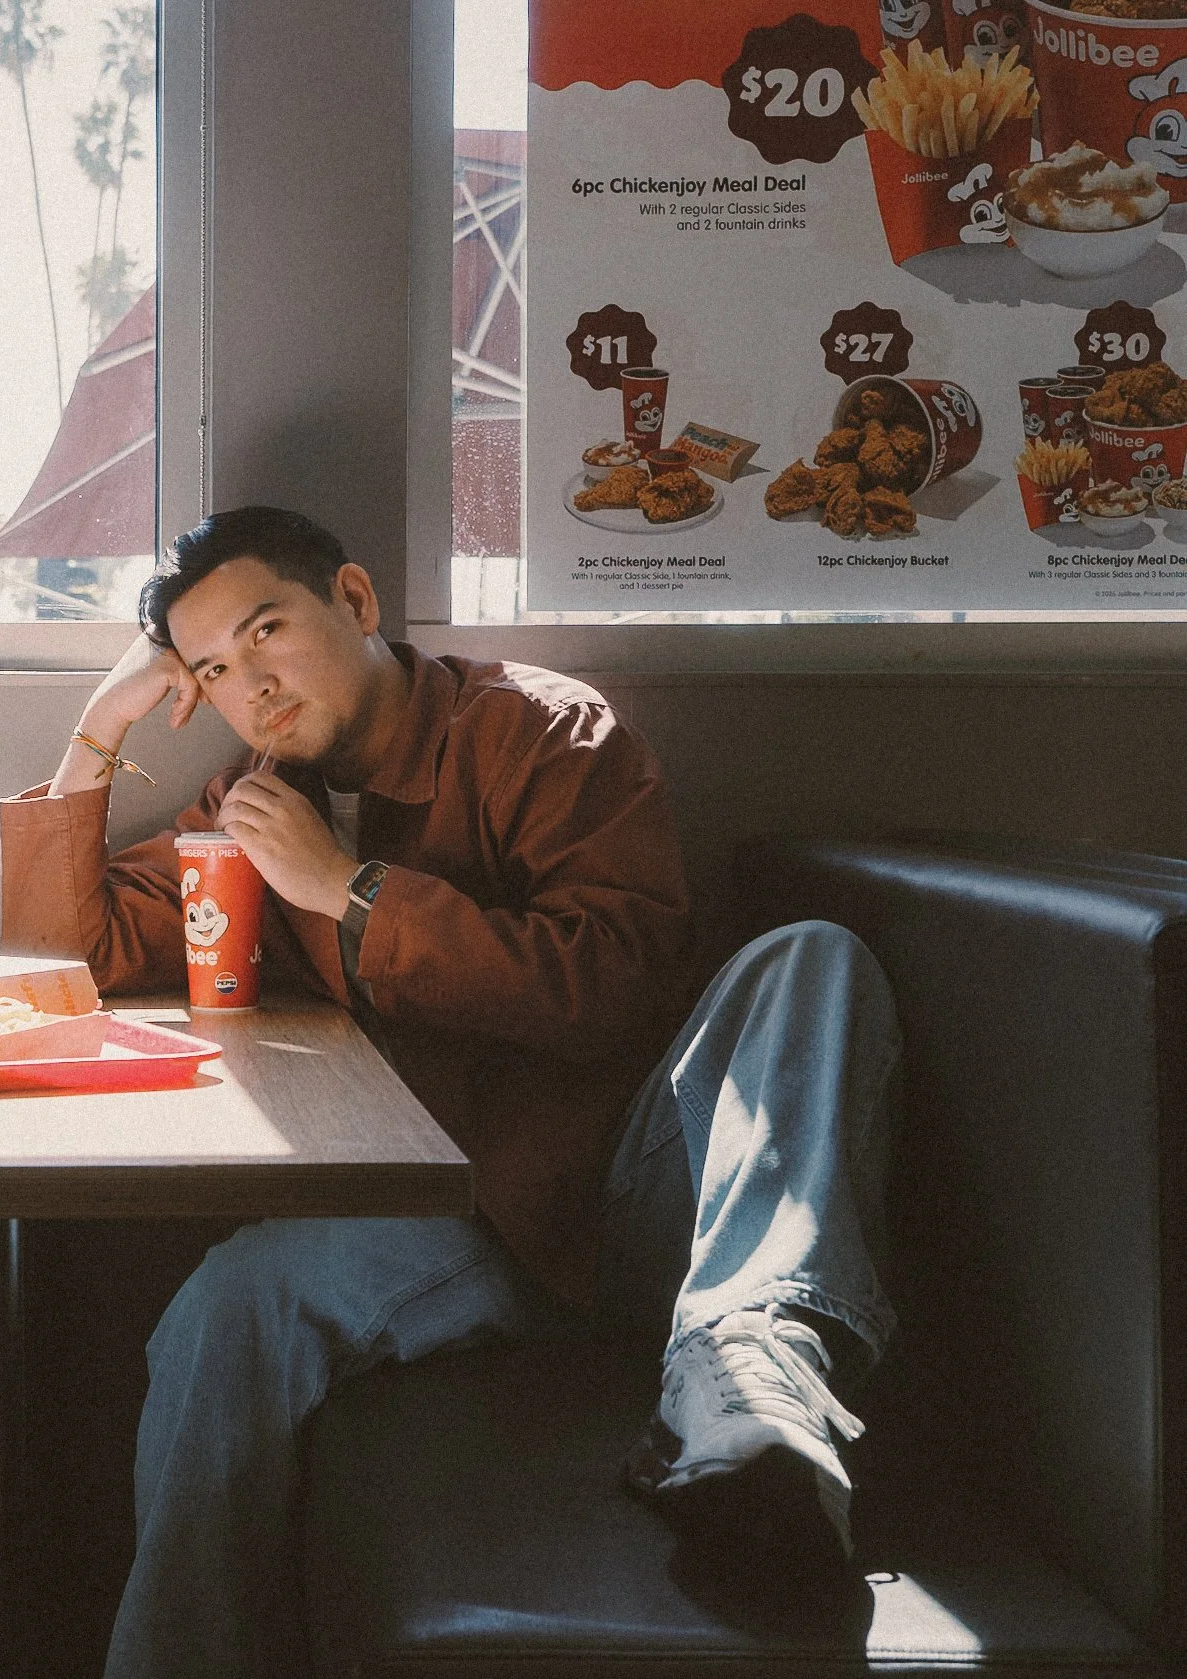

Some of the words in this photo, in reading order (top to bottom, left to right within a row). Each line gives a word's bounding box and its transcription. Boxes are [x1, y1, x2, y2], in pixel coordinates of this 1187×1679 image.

[1033, 15, 1160, 68] Jollibee
[739, 66, 845, 118] $20
[901, 170, 949, 184] Jollibee
[571, 178, 604, 197] 6pc
[610, 176, 706, 197] Chickenjoy
[712, 176, 758, 193] Meal
[764, 175, 806, 192] Deal
[639, 203, 665, 215] With
[669, 203, 677, 215] 2
[681, 202, 724, 217] regular
[727, 202, 770, 214] Classic
[773, 201, 806, 213] Sides
[677, 219, 700, 231] and
[704, 219, 711, 230] 2
[715, 218, 764, 230] fountain
[768, 218, 806, 229] drinks
[582, 334, 628, 364] $11
[834, 332, 893, 363] $27
[1088, 331, 1150, 361] $30
[1088, 425, 1146, 448] Jollibee
[577, 556, 598, 569] 2pc
[601, 556, 663, 569] Chickenjoy
[666, 556, 696, 567] Meal
[699, 556, 726, 567] Deal
[817, 555, 843, 568] 12pc
[846, 555, 908, 568] Chickenjoy
[910, 555, 949, 566] Bucket
[1047, 555, 1069, 567] 8pc
[1071, 554, 1134, 567] Chickenjoy
[1137, 555, 1167, 566] Meal
[1170, 555, 1187, 565] De
[571, 572, 588, 580] With
[595, 572, 623, 582] regular
[624, 572, 651, 580] Classic
[652, 572, 671, 581] Side,
[677, 572, 708, 580] fountain
[710, 572, 732, 581] drink,
[1054, 571, 1082, 580] regular
[1083, 570, 1110, 578] Classic
[1112, 570, 1133, 578] Sides
[619, 582, 635, 590] and
[641, 582, 670, 590] dessert
[671, 582, 684, 591] pie
[218, 849, 238, 858] PIES
